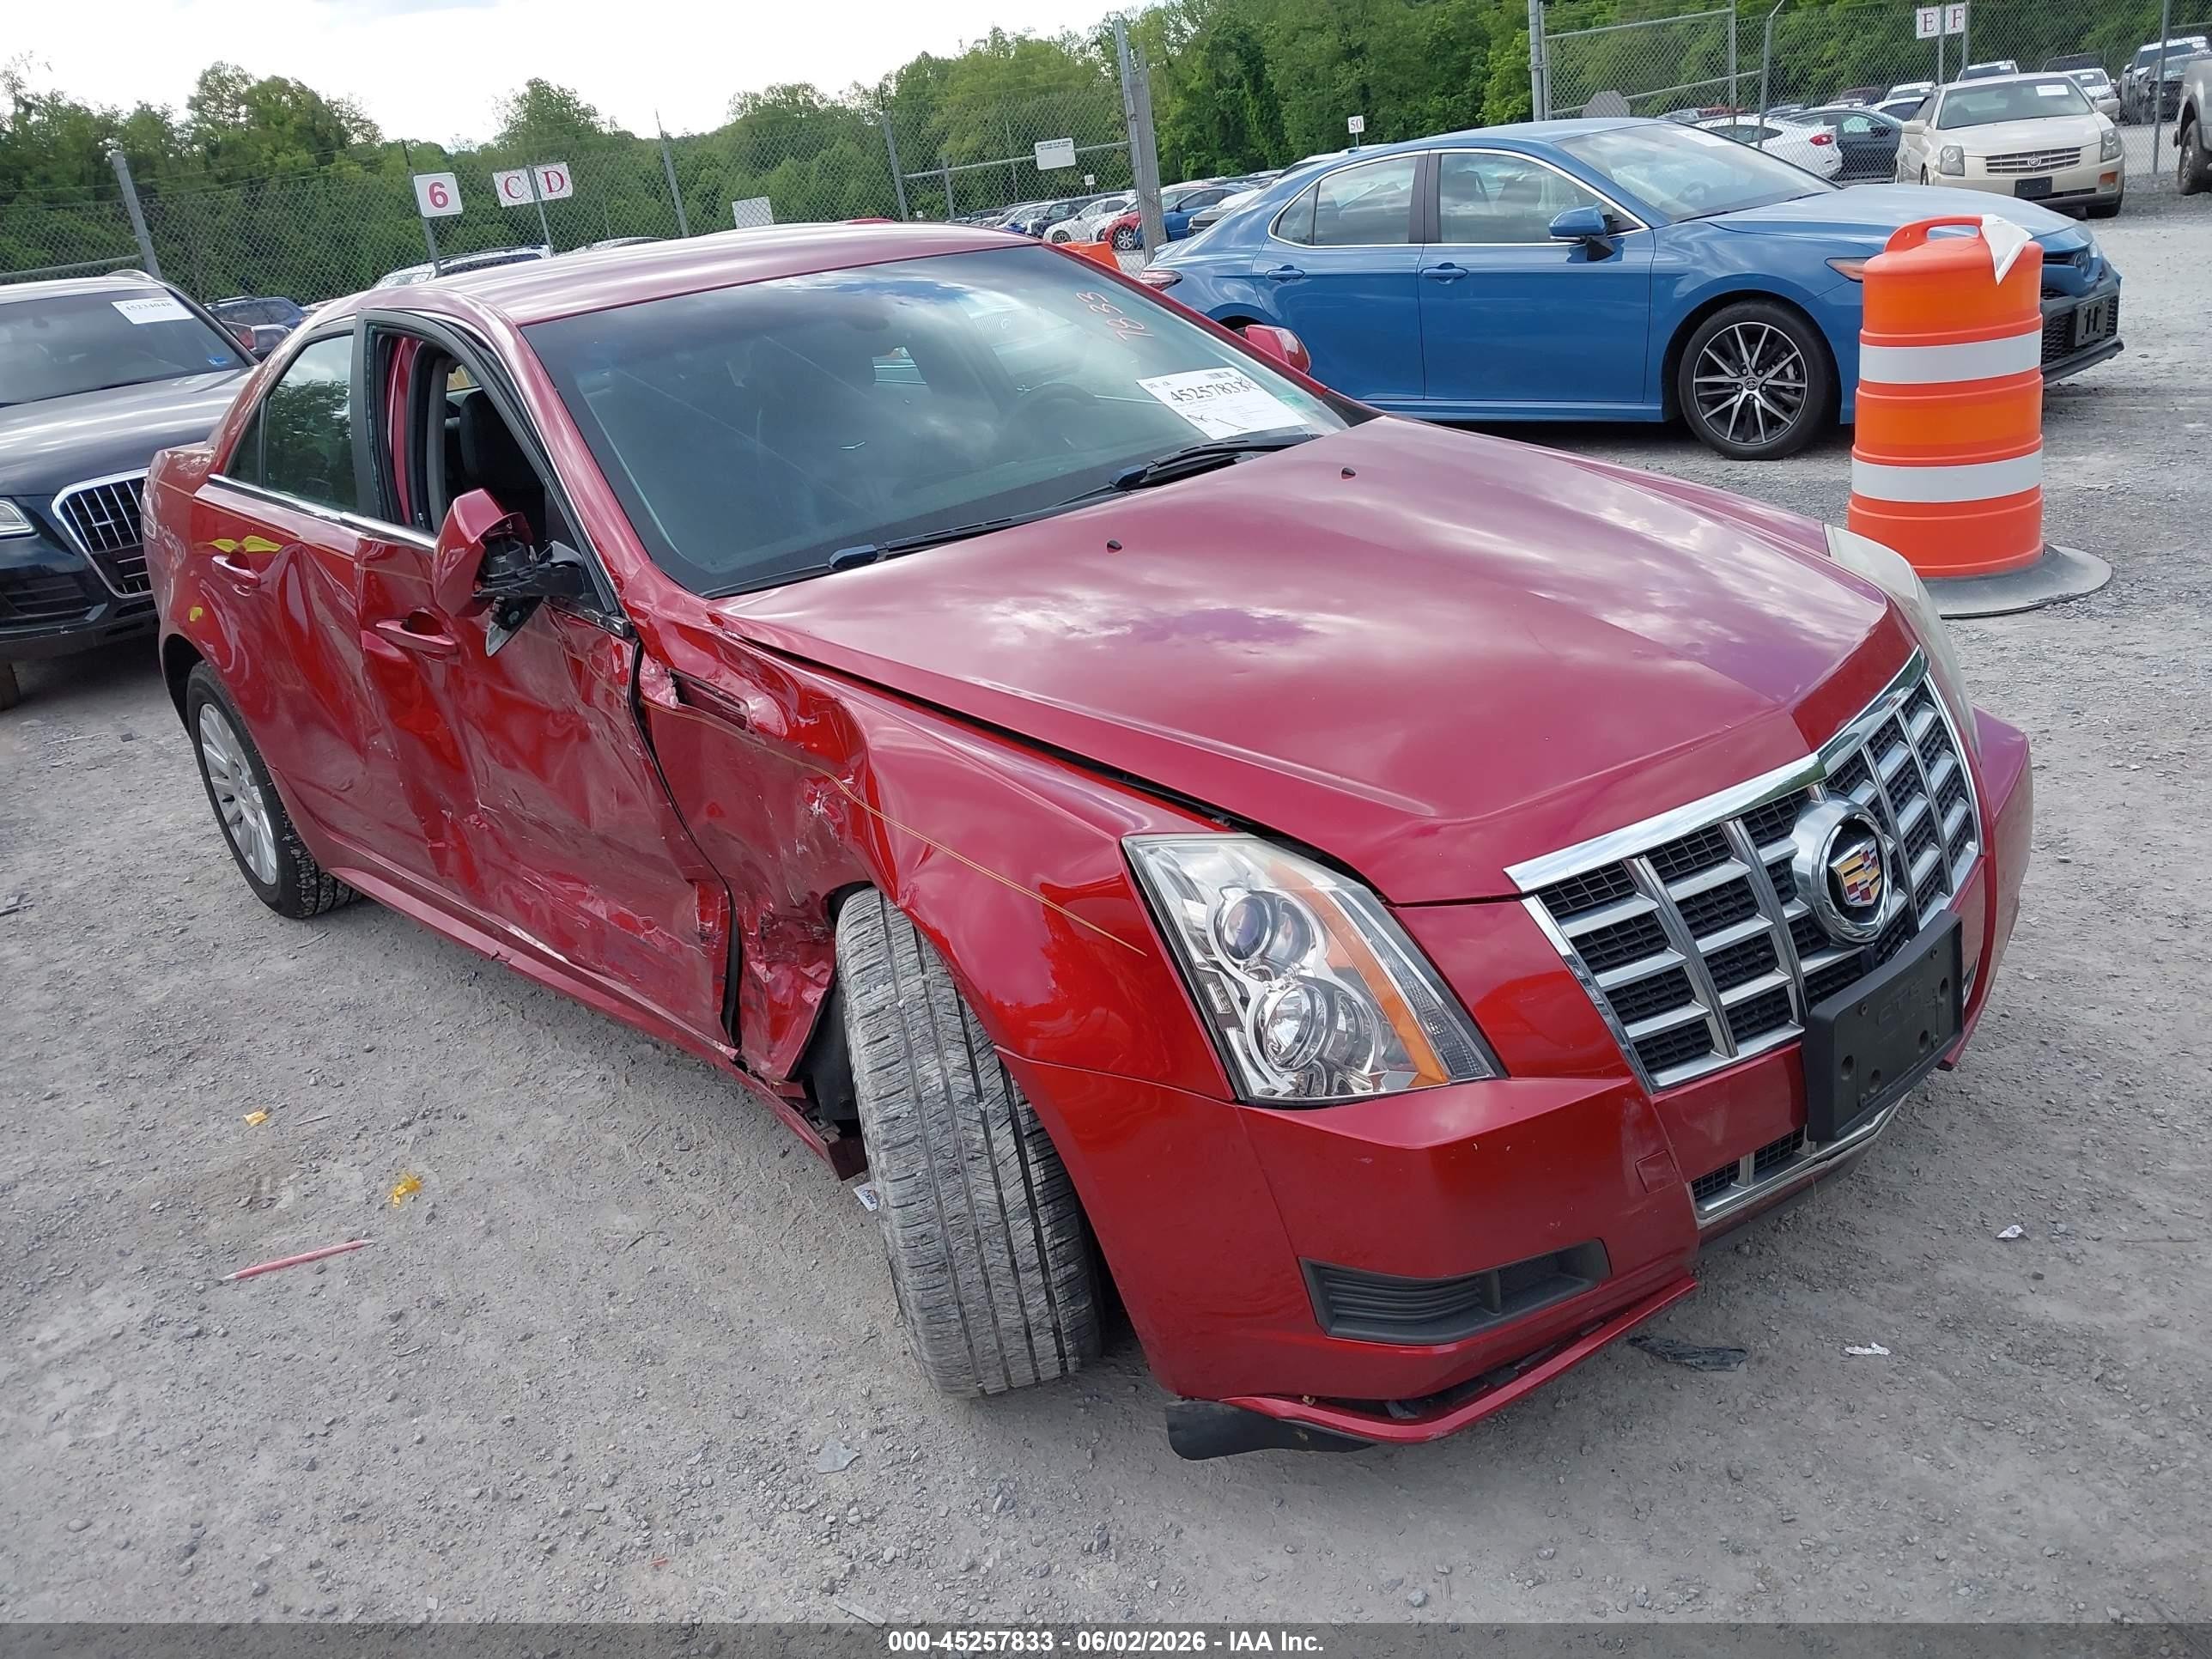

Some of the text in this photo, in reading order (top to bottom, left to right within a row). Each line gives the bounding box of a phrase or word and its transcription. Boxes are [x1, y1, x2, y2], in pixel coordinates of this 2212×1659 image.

[1923, 12, 1935, 33] E
[1950, 8, 1964, 29] F
[1350, 118, 1363, 131] 50
[503, 175, 525, 199] C
[541, 170, 565, 193] D
[428, 181, 449, 209] 6
[1075, 291, 1155, 342] 7833
